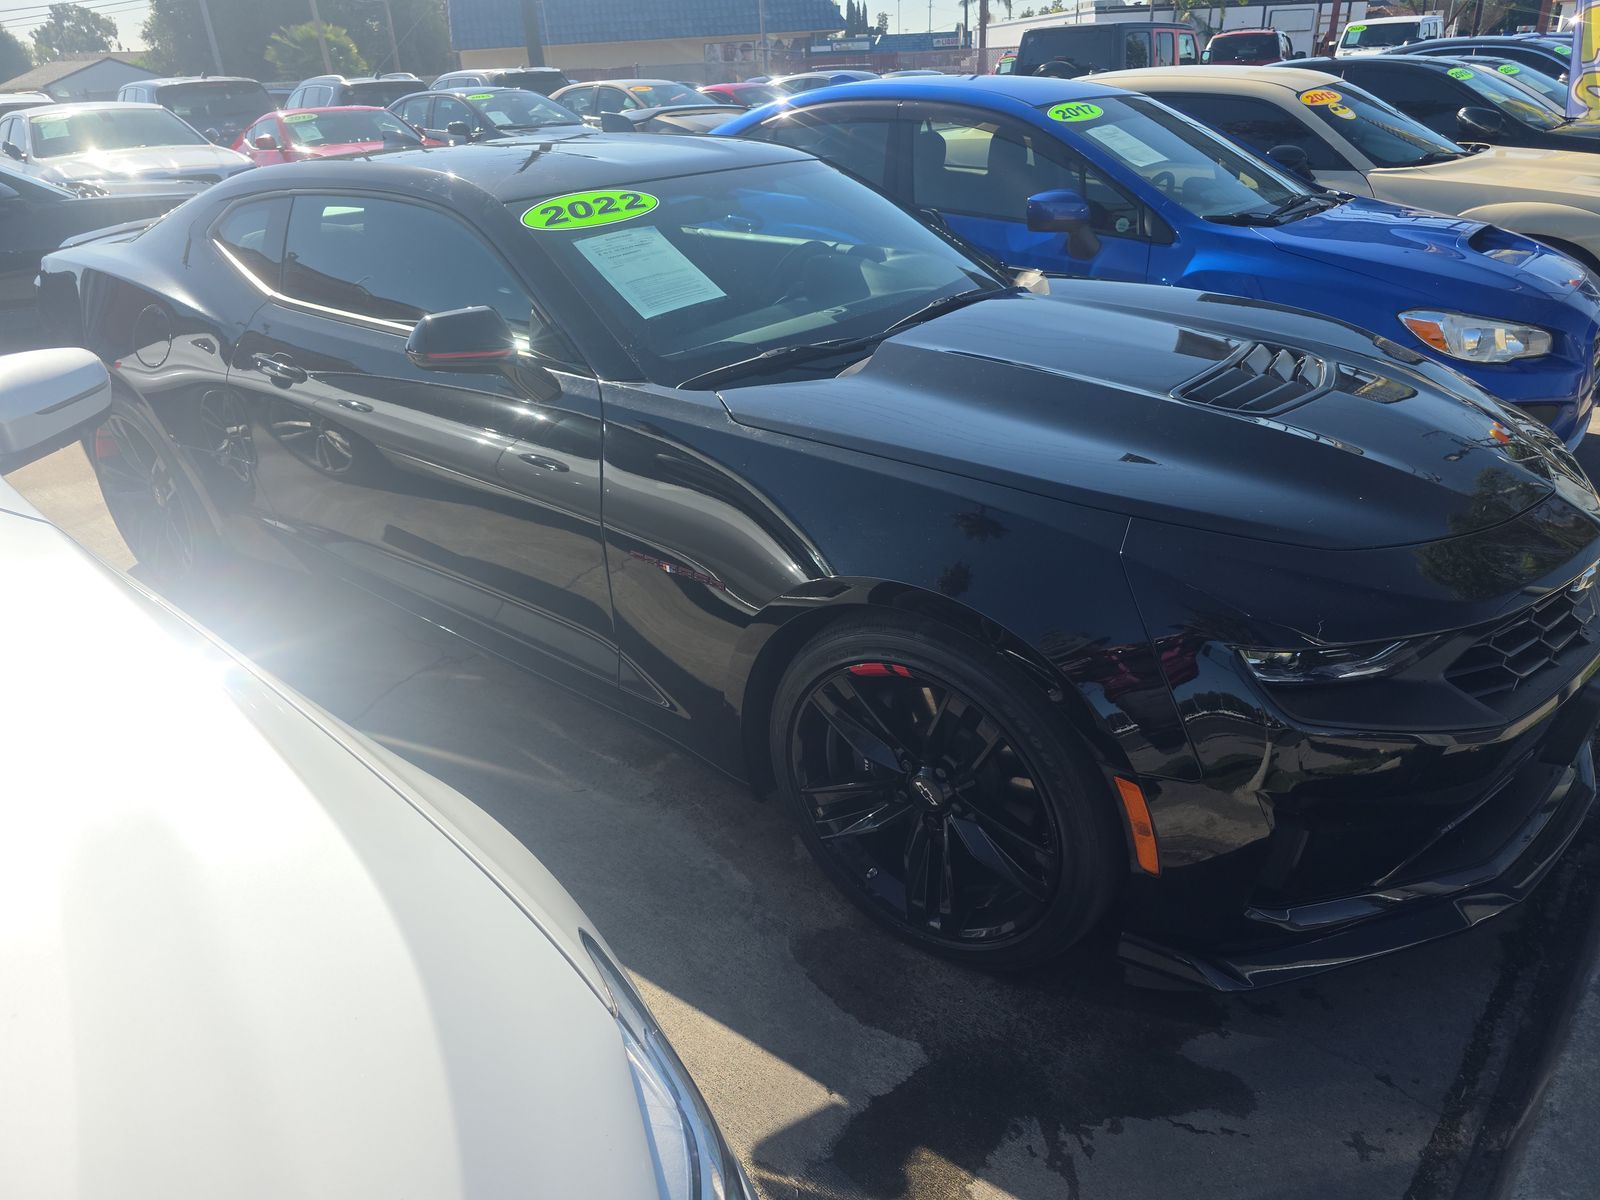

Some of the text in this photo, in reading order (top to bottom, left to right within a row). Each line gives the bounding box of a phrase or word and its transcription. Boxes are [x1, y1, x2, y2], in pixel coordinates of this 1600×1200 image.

[1305, 91, 1338, 104] 2015
[1055, 104, 1096, 119] 2017
[540, 193, 647, 227] 2022
